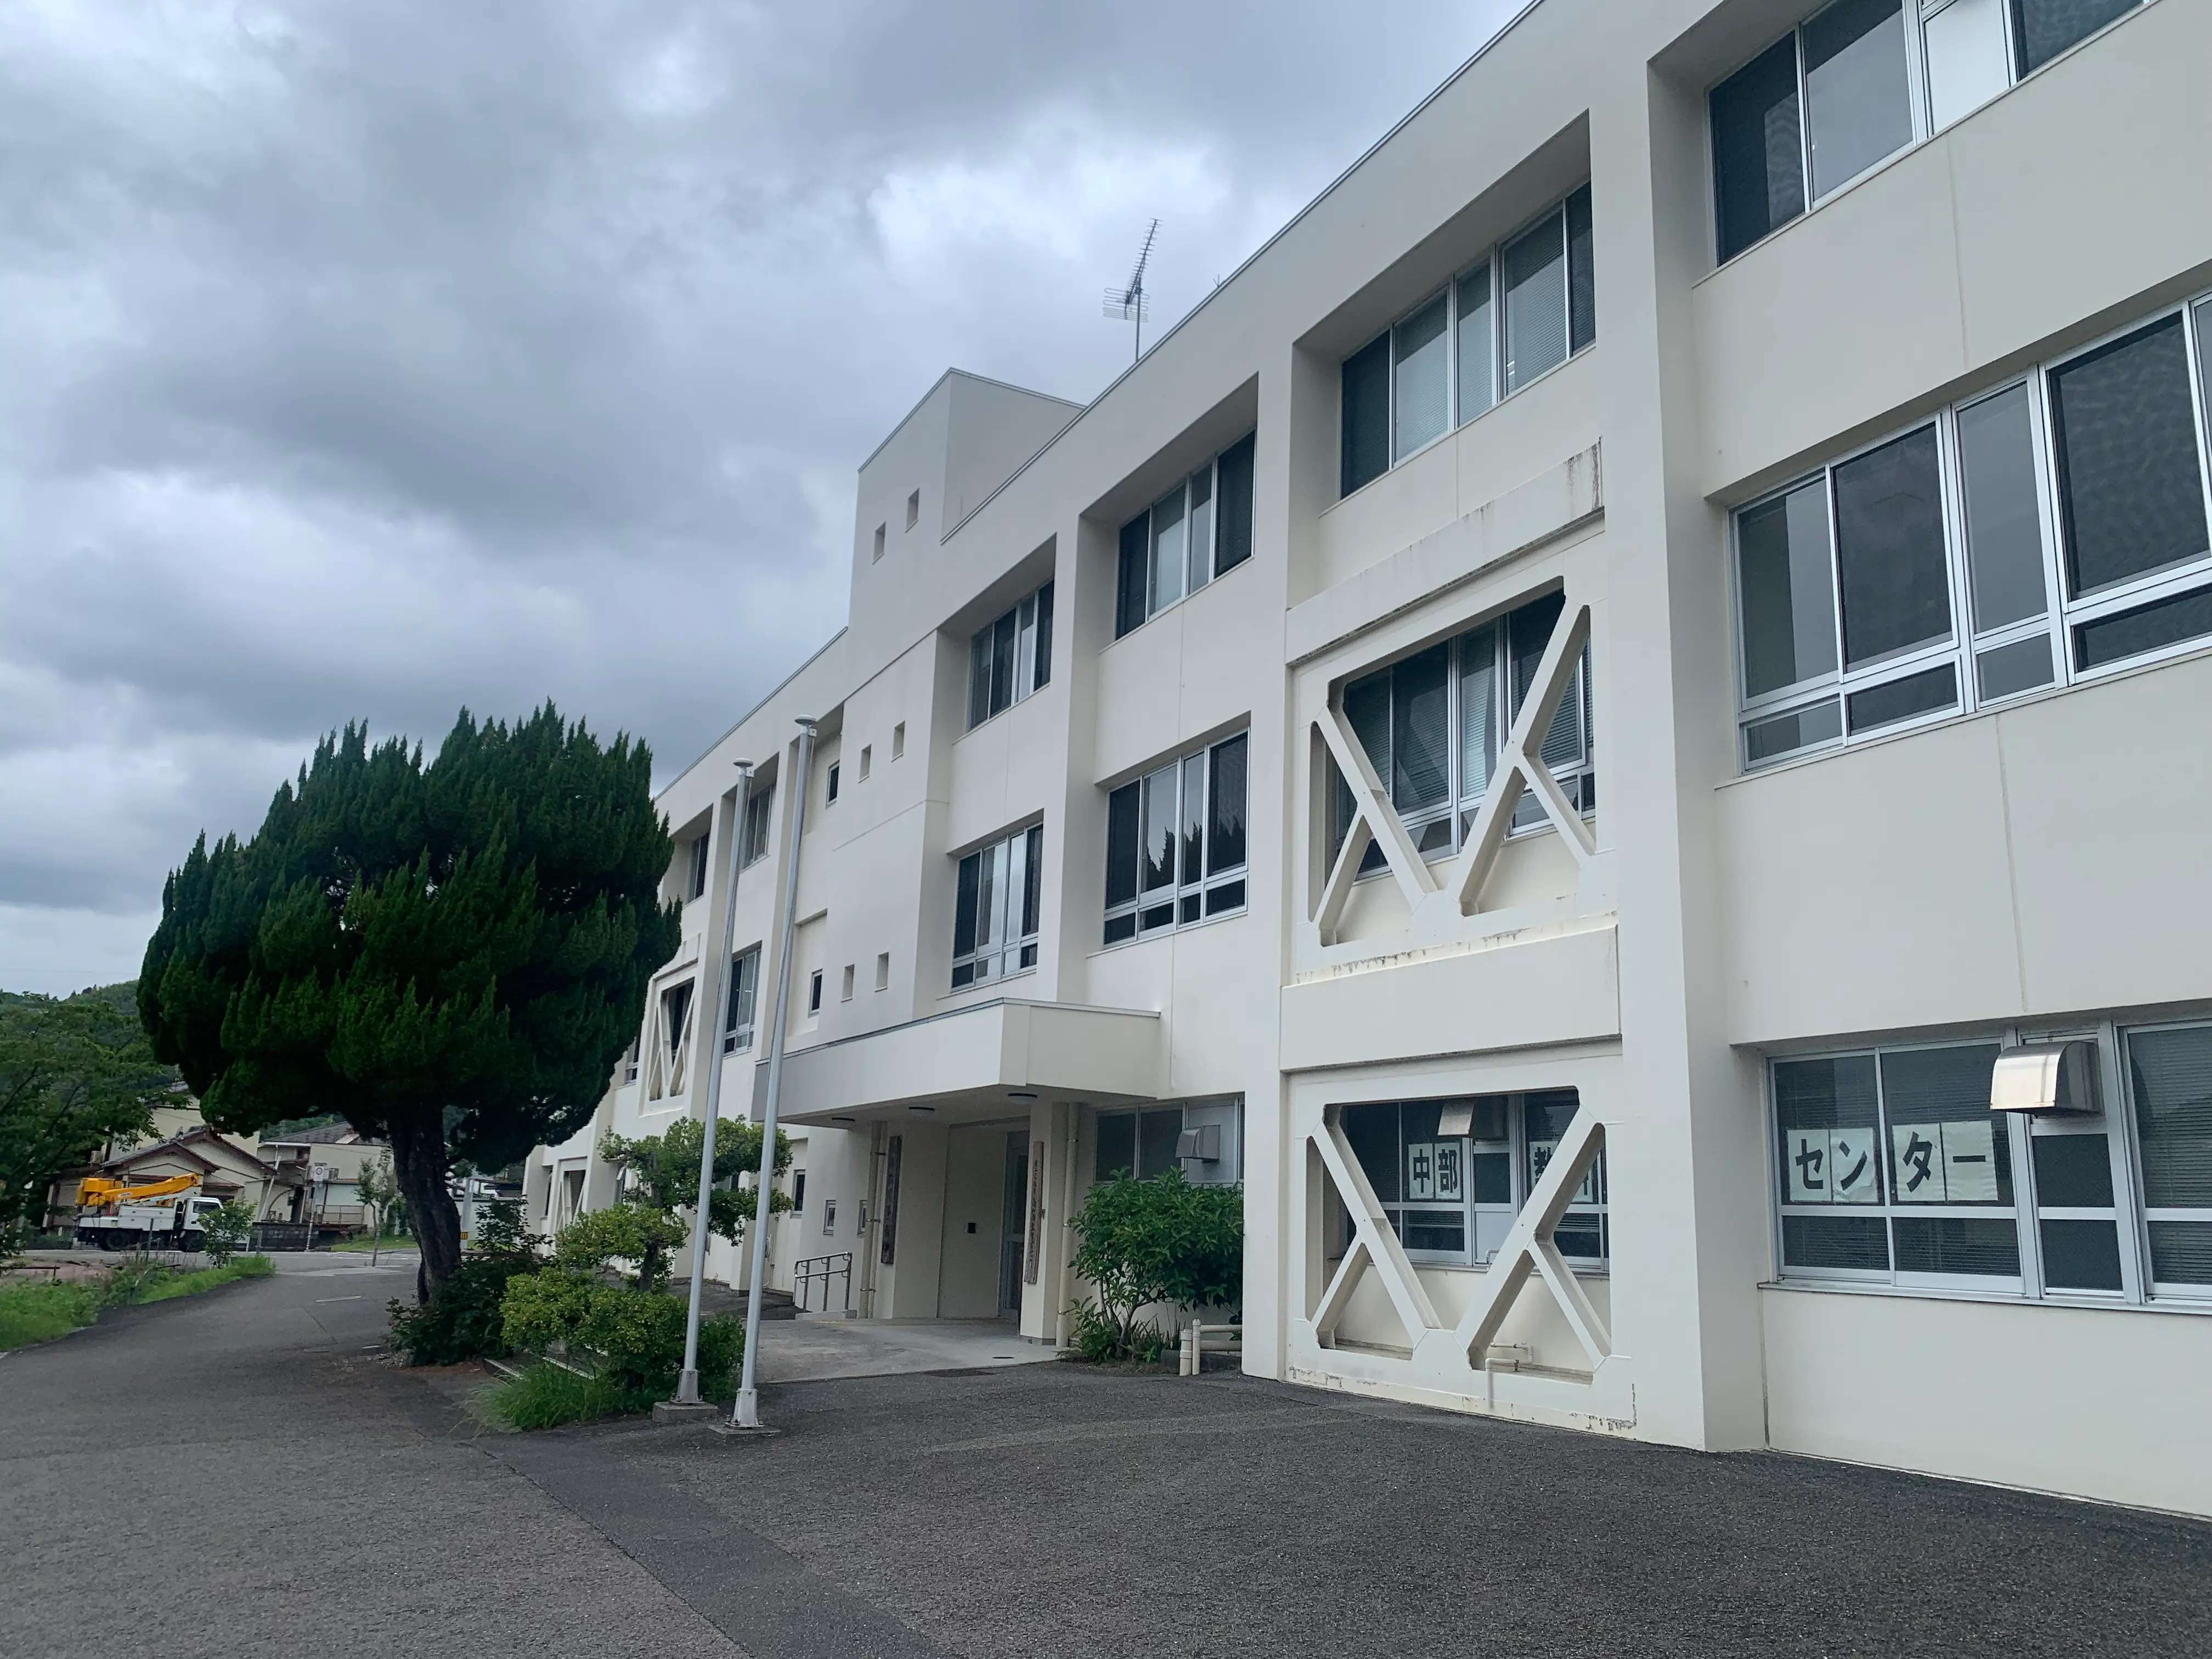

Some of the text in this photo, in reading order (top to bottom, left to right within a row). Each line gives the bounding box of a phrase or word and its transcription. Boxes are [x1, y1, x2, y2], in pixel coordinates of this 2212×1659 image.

[1413, 1148, 1458, 1193] 中部
[1795, 1131, 1987, 1193] センター
